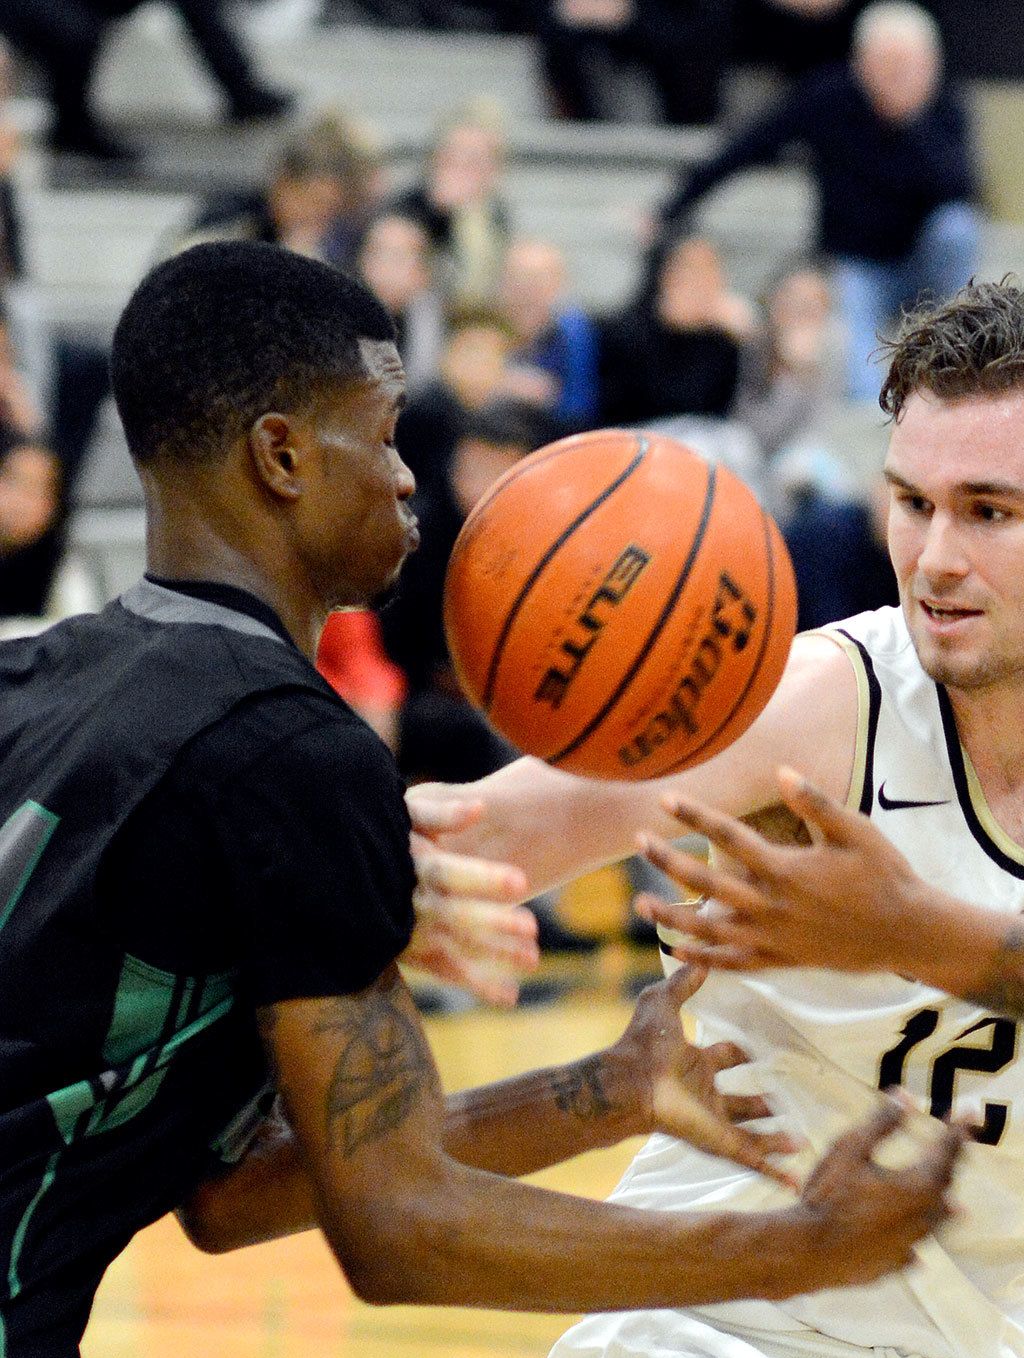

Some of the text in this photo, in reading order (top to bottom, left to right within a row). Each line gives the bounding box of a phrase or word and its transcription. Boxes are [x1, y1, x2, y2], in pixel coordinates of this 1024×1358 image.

[533, 545, 652, 711] ELITE
[618, 573, 758, 767] Baden
[878, 1009, 1017, 1147] 12
